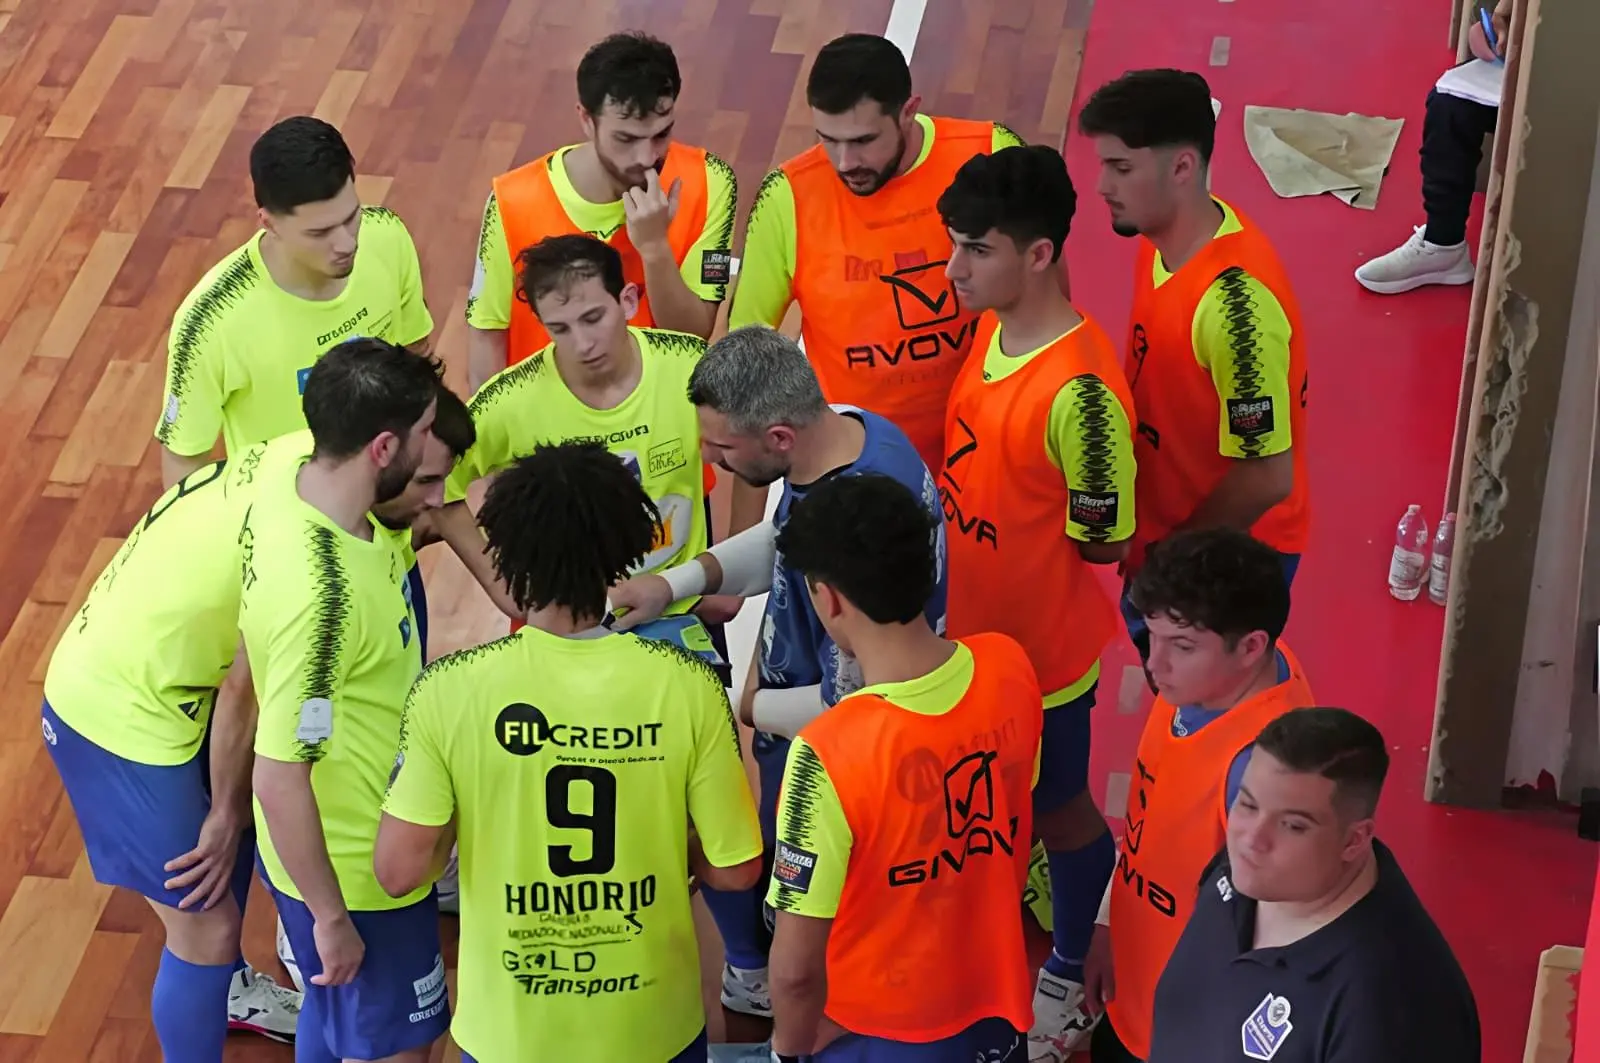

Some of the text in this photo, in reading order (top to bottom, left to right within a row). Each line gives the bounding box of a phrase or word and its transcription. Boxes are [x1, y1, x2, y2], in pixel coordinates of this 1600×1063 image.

[545, 764, 616, 878] 9
[505, 874, 656, 916] HONORIO
[514, 974, 640, 997] Transport
